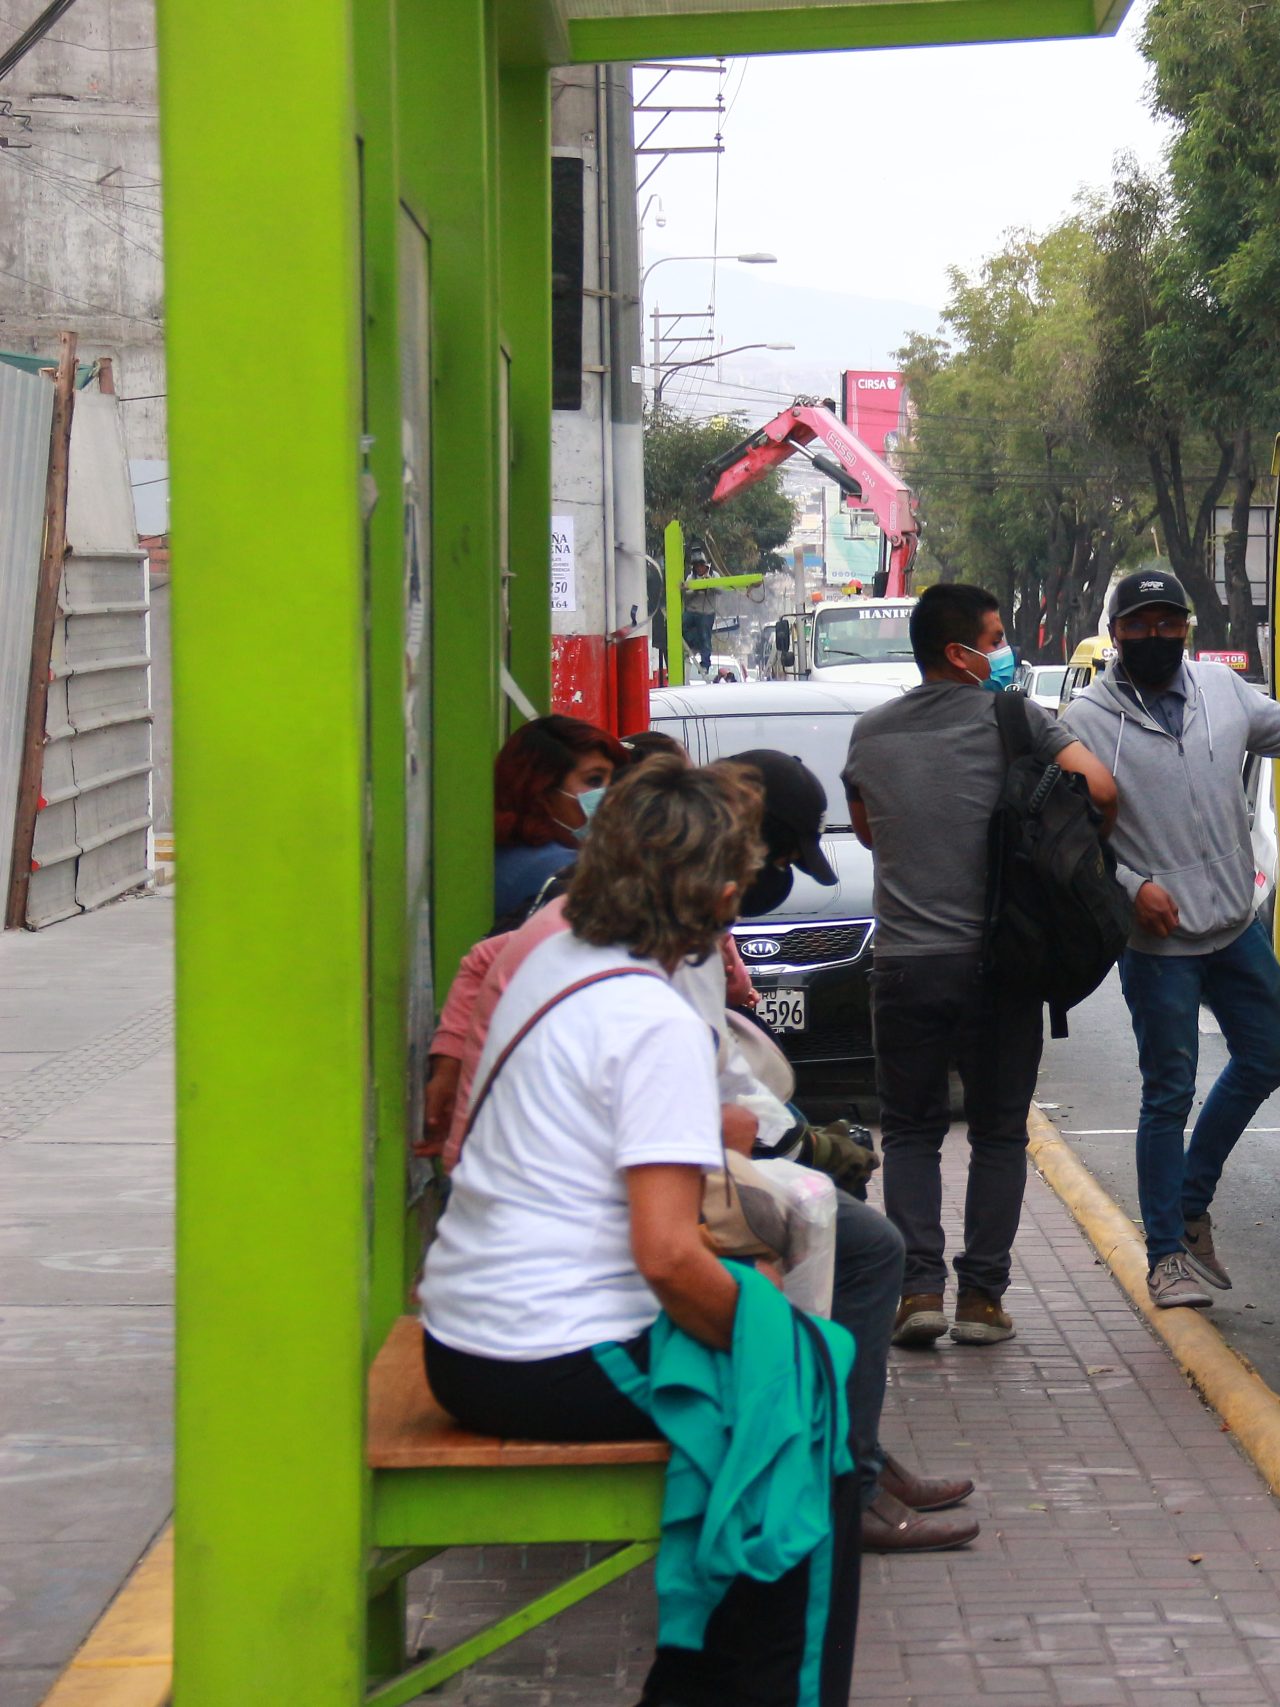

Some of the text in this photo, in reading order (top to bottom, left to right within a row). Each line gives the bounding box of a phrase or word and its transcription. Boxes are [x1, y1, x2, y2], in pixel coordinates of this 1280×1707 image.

[858, 378, 886, 390] CIRSA
[828, 431, 856, 465] FASSI
[552, 531, 567, 544] ÑA
[552, 581, 568, 593] 50
[859, 608, 913, 620] HANIF
[1213, 655, 1245, 664] A-105
[747, 943, 774, 954] KIA
[761, 990, 778, 1000] RU
[754, 1000, 803, 1026] -596
